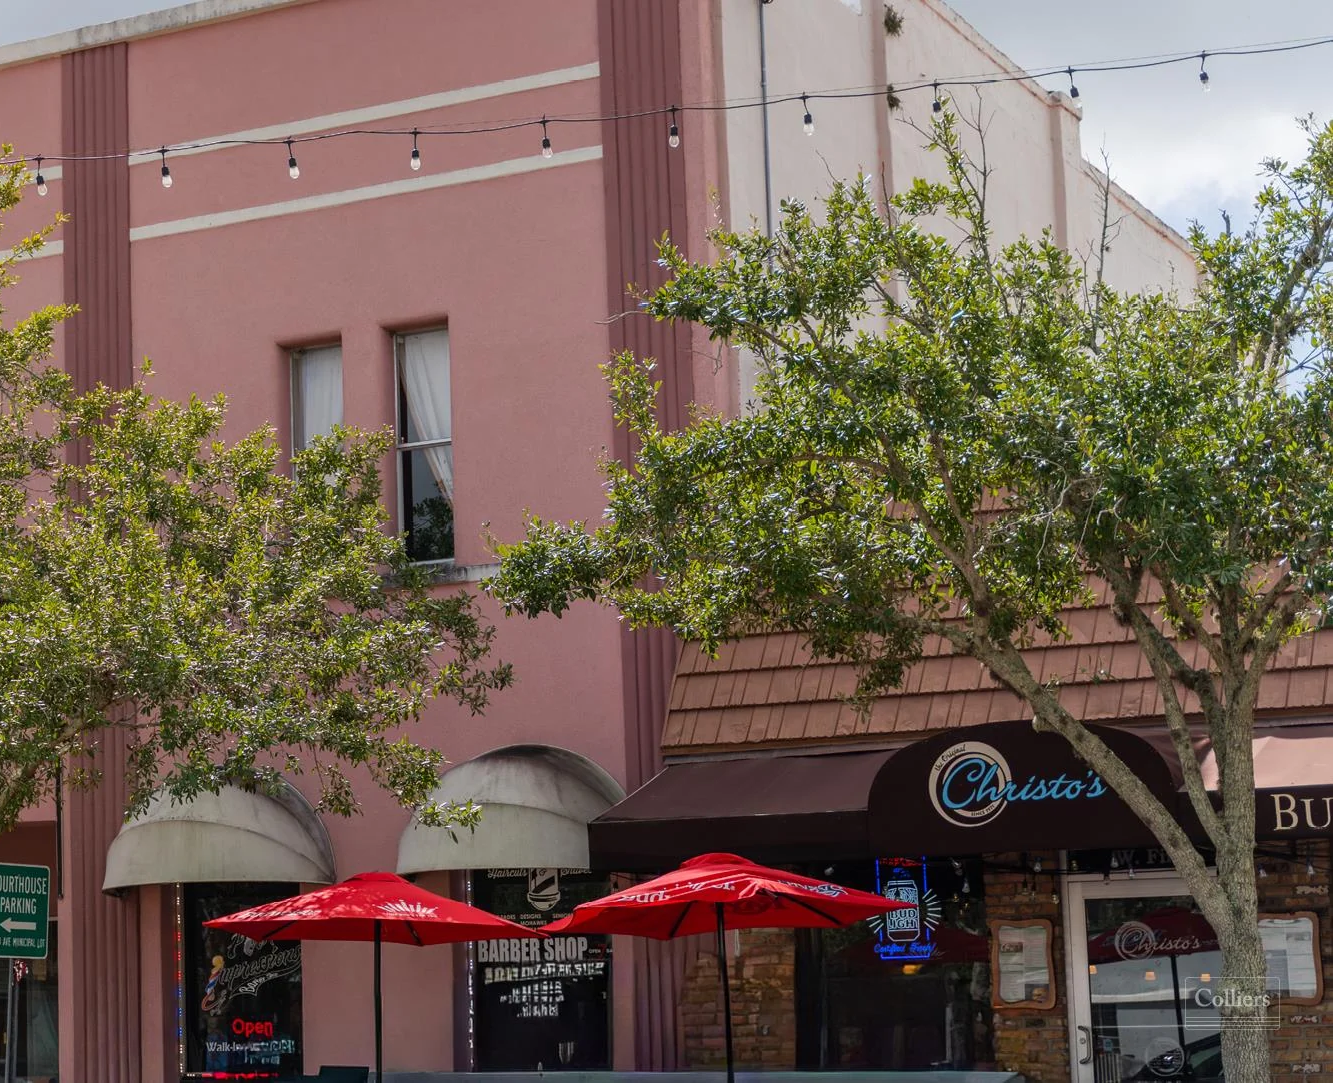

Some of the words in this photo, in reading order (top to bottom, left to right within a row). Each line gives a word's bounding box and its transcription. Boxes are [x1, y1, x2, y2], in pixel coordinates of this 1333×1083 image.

[941, 743, 966, 762] Original
[941, 757, 1108, 810] Christo's
[0, 897, 37, 915] PARKING
[889, 909, 917, 920] BUD
[2, 937, 11, 947] AVE
[12, 937, 36, 948] MUNICIPAL
[36, 938, 46, 949] LOT
[477, 938, 541, 963] BARBER
[543, 937, 588, 962] SHOP
[1121, 929, 1201, 954] Christo's
[232, 1018, 274, 1037] Open
